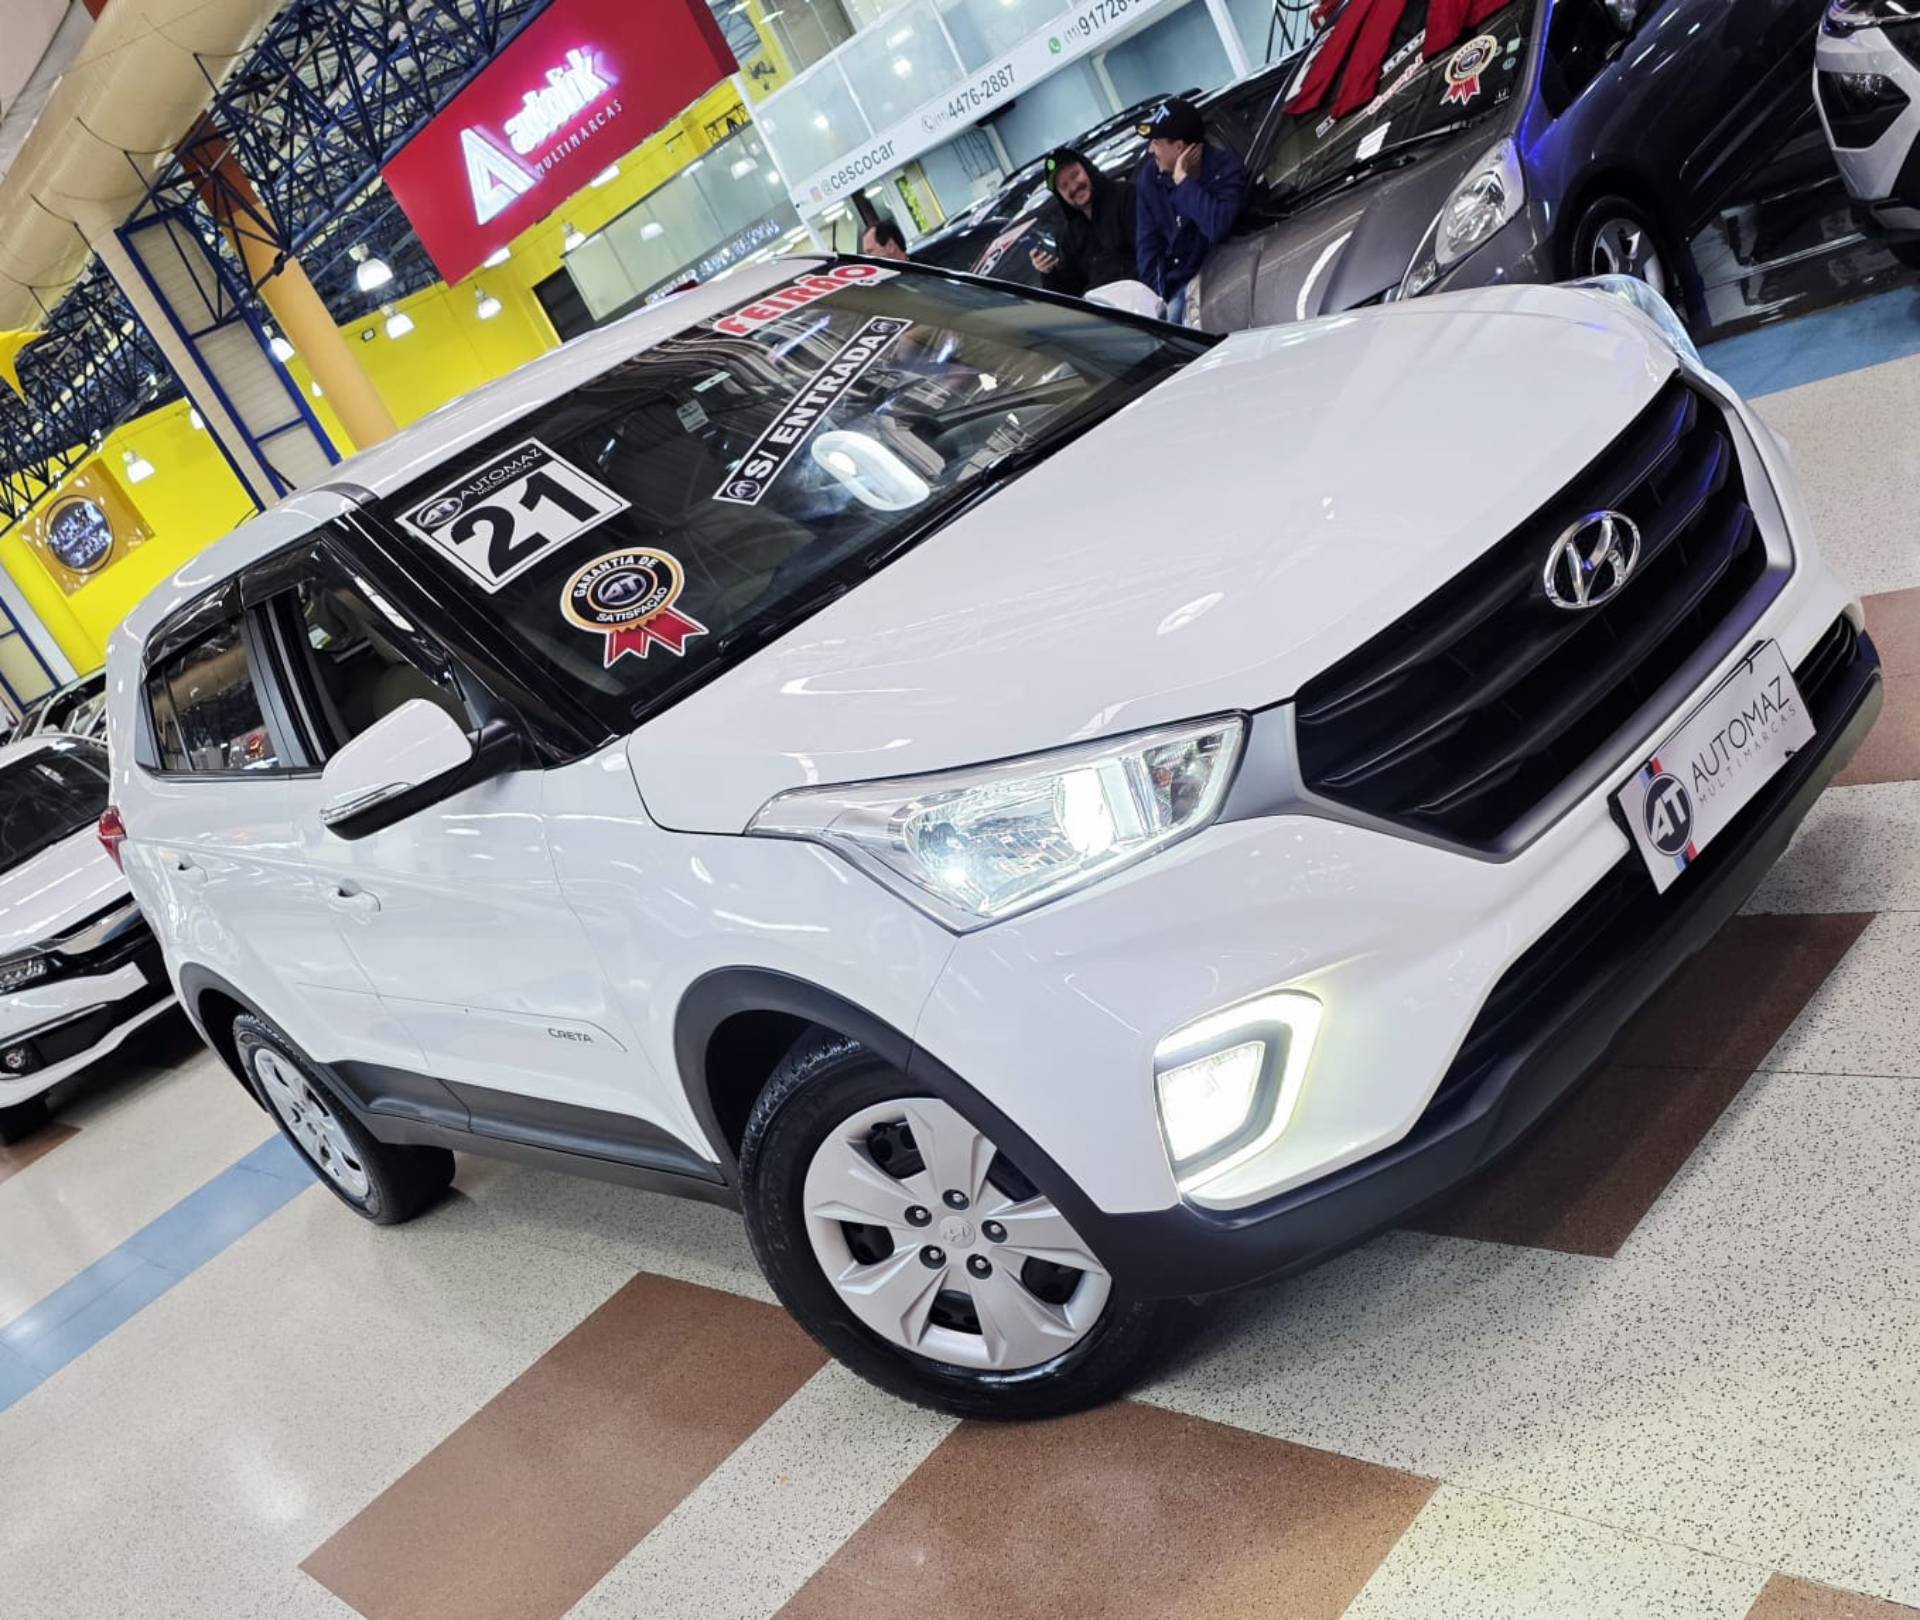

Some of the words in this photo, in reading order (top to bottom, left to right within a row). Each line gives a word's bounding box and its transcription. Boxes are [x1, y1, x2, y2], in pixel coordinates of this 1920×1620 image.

[536, 98, 623, 176] MULTIMARCAS
[716, 265, 879, 334] FEIRÃO
[744, 450, 780, 478] S/
[769, 335, 888, 444] ENTRADA
[461, 448, 542, 500] AUTOMAZ
[451, 472, 600, 579] 21
[574, 555, 634, 598] GARANTIA
[638, 556, 659, 568] DE
[1691, 675, 1790, 792] AUTOMAZ
[1699, 704, 1797, 804] MULTIMARCAS
[548, 1027, 594, 1043] CRETA
